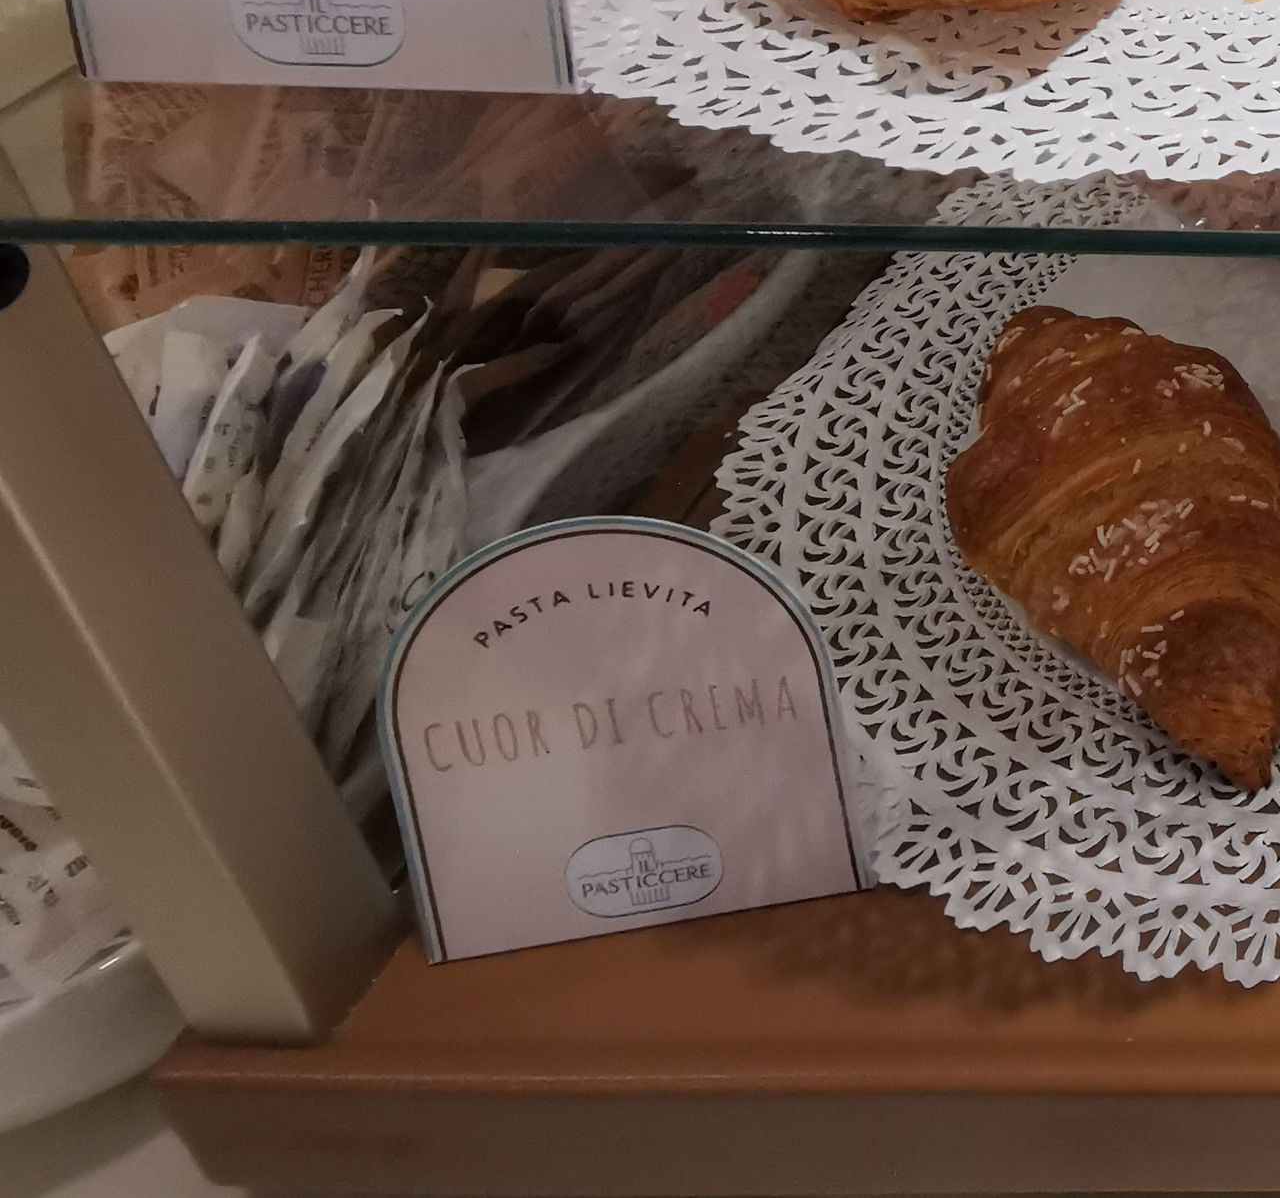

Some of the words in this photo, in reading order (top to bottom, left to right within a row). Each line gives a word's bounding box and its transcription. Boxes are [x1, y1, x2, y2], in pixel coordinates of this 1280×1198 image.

[246, 13, 392, 36] PASTICCERE
[473, 590, 571, 649] PASTA
[587, 581, 712, 617] LIEVITA
[424, 711, 551, 773] CUOR
[572, 698, 625, 751] DI
[648, 676, 799, 739] CREMA
[582, 863, 711, 899] PASTICCERE
